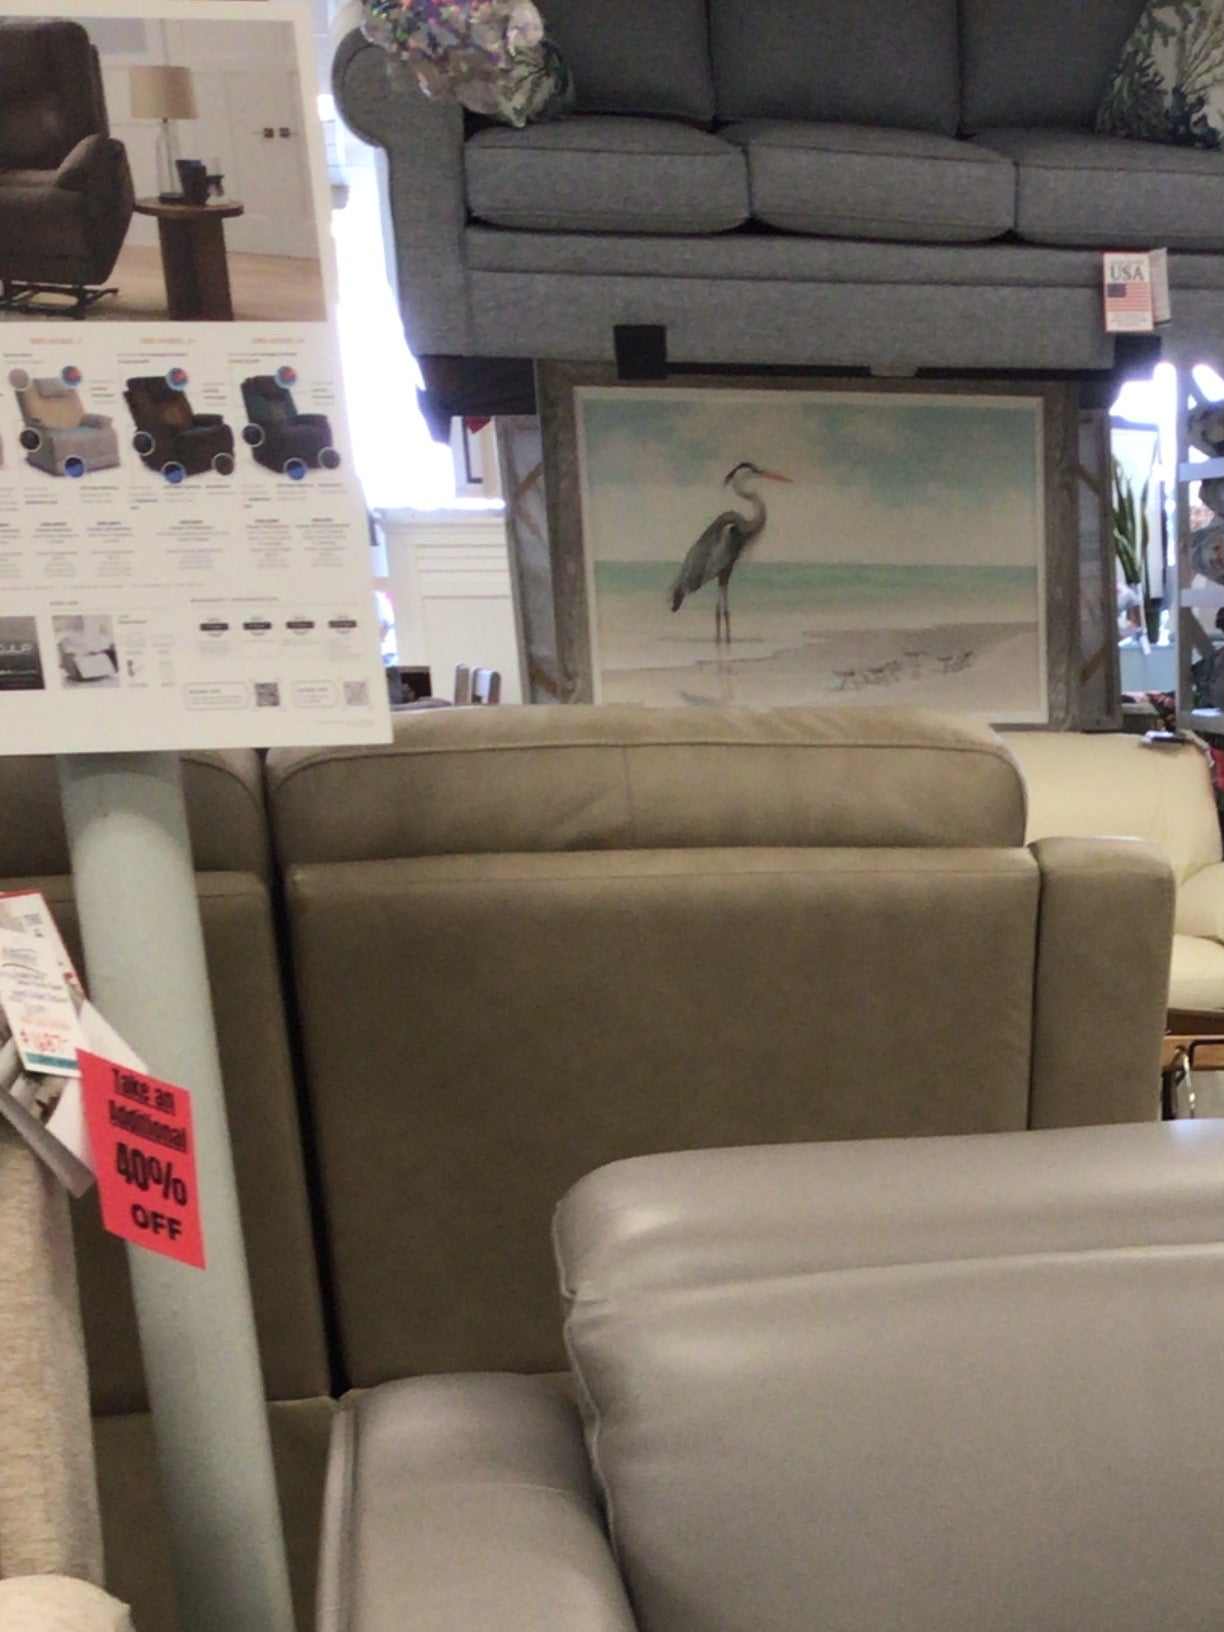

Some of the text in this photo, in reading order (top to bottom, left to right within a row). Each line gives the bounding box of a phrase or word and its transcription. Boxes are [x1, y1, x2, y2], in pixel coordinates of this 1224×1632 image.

[1109, 264, 1145, 281] USA
[116, 1141, 188, 1206] 40%
[131, 1203, 182, 1241] OFF
